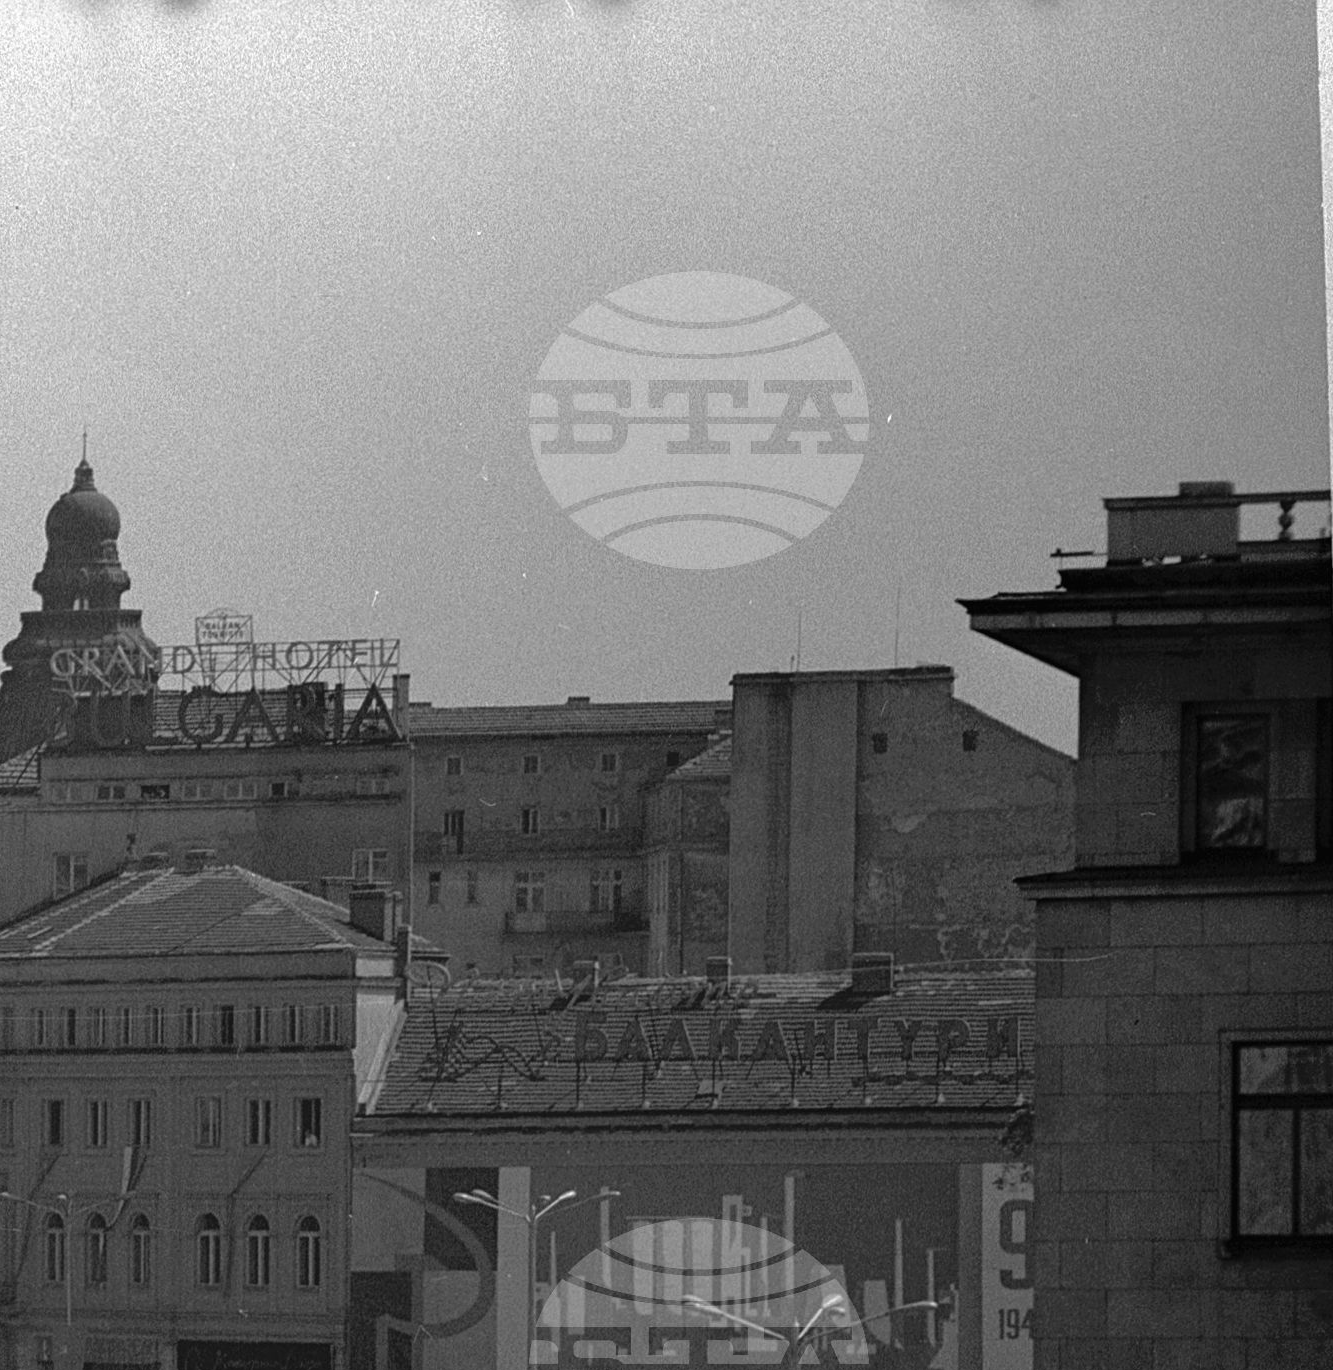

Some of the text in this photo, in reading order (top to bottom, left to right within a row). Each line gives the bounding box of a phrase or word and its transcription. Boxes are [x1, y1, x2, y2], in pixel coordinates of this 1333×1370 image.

[50, 638, 400, 677] GRAND HOTEL
[999, 1200, 1034, 1290] 9
